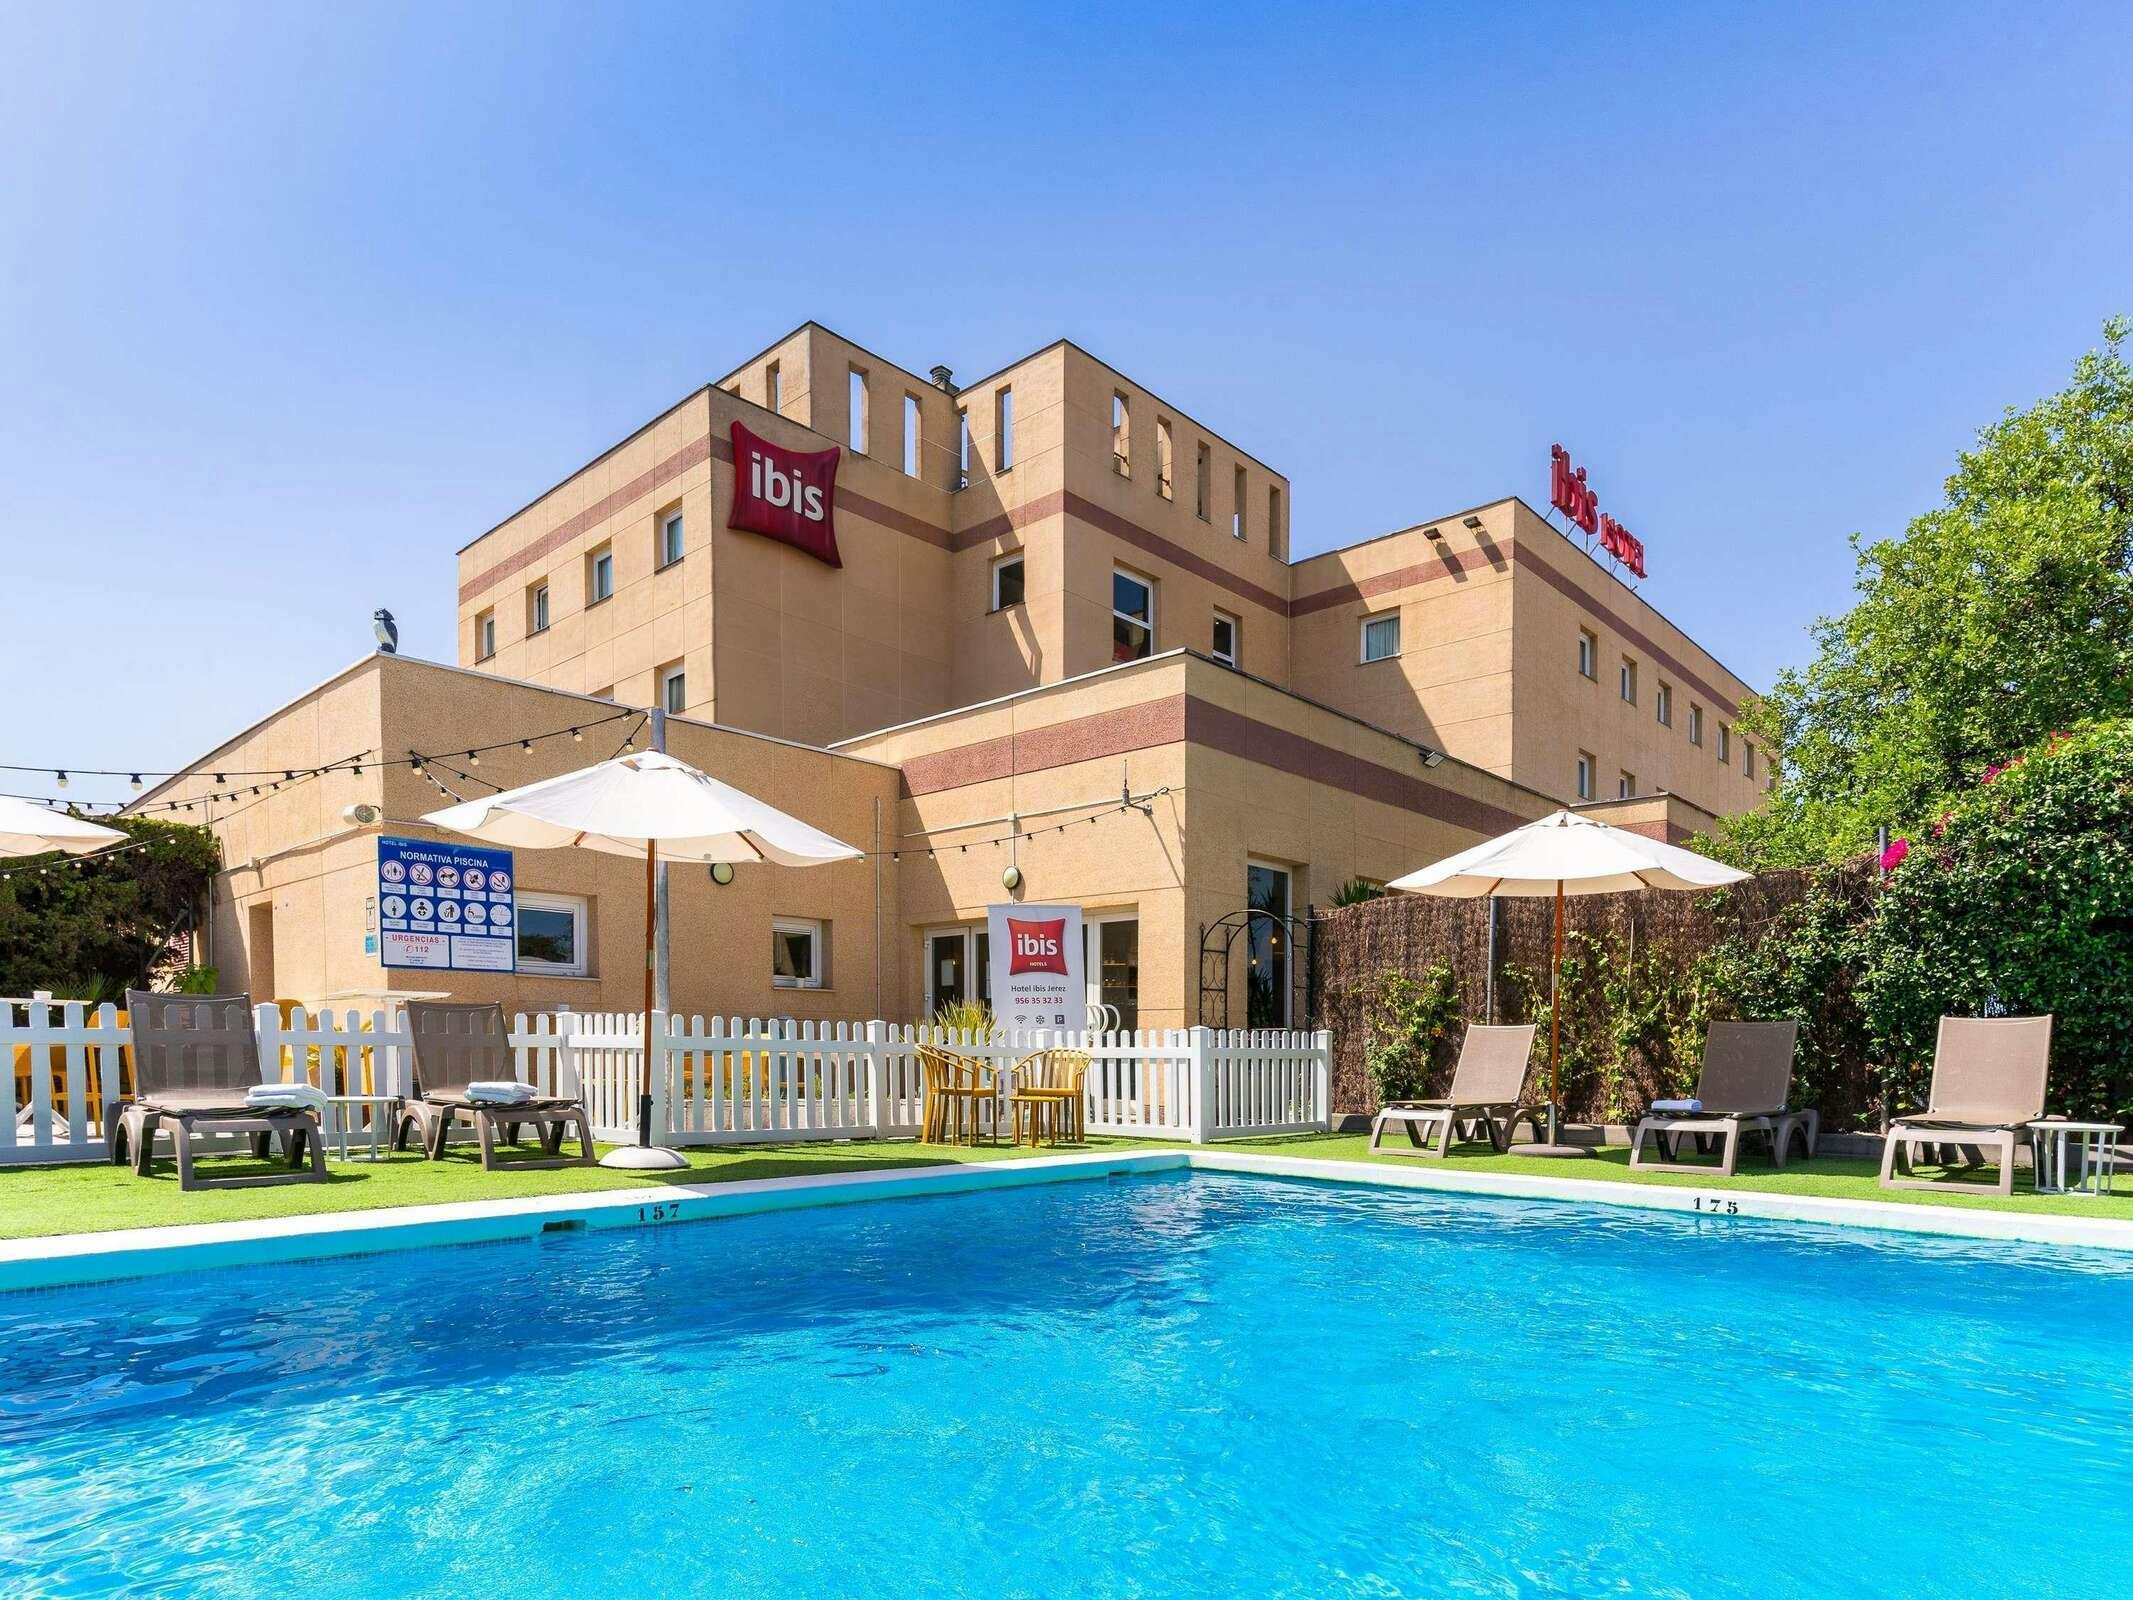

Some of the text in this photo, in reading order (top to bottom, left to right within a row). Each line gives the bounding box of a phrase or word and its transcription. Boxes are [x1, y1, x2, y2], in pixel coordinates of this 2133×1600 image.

[751, 450, 824, 522] ibis
[1551, 443, 1599, 535] ibis
[400, 850, 489, 869] NORMATIVA PISCINA
[391, 934, 440, 944] URGENCIAS
[1017, 933, 1058, 956] ibis
[1033, 984, 1046, 992] ibis
[1047, 984, 1067, 992] Jerez
[1015, 997, 1064, 1005] 956 35 32 33
[639, 1203, 680, 1221] 157
[1693, 1197, 1738, 1215] 175
